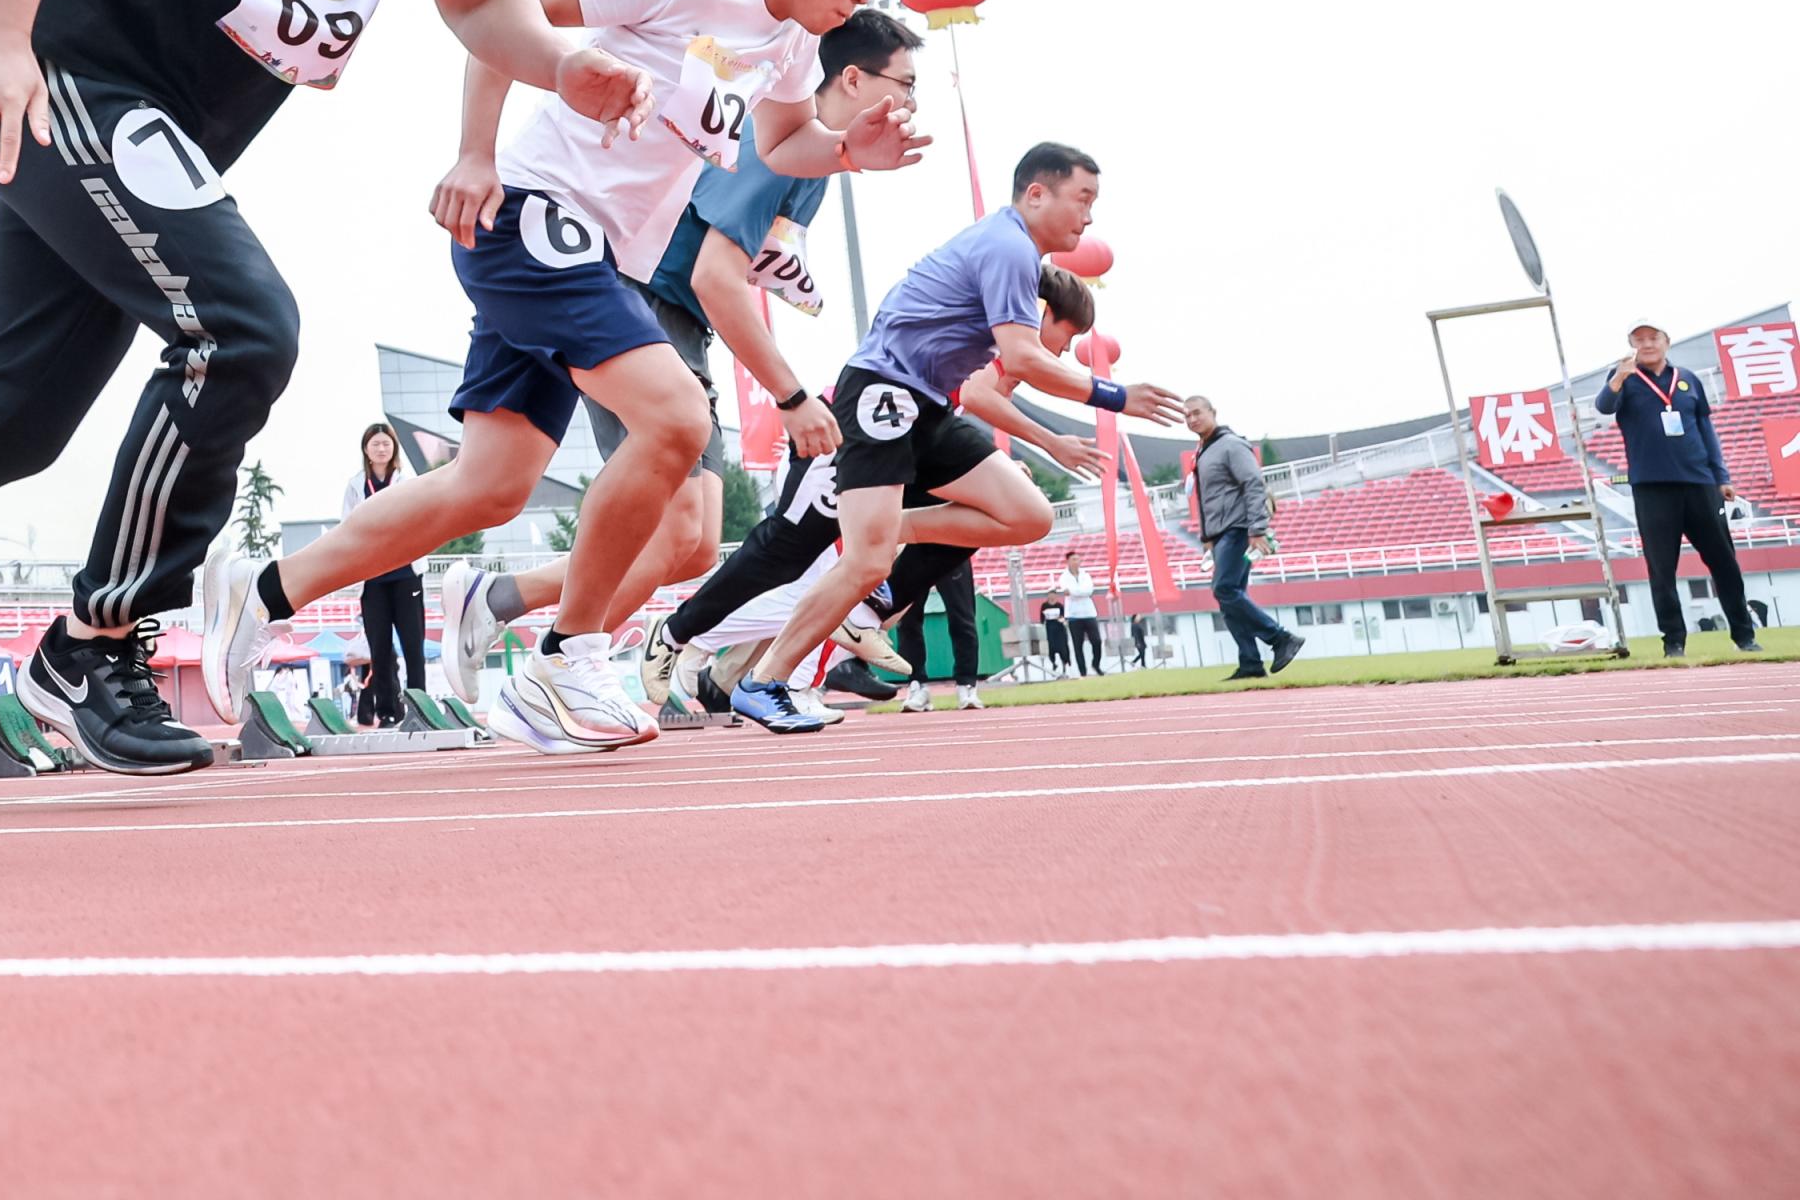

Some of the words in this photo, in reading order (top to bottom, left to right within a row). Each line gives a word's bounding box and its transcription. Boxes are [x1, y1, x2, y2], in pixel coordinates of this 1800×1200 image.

[127, 118, 207, 190] 7
[545, 202, 592, 255] 6
[872, 392, 905, 428] 4
[1479, 395, 1553, 465] 体
[1720, 326, 1795, 398] 育
